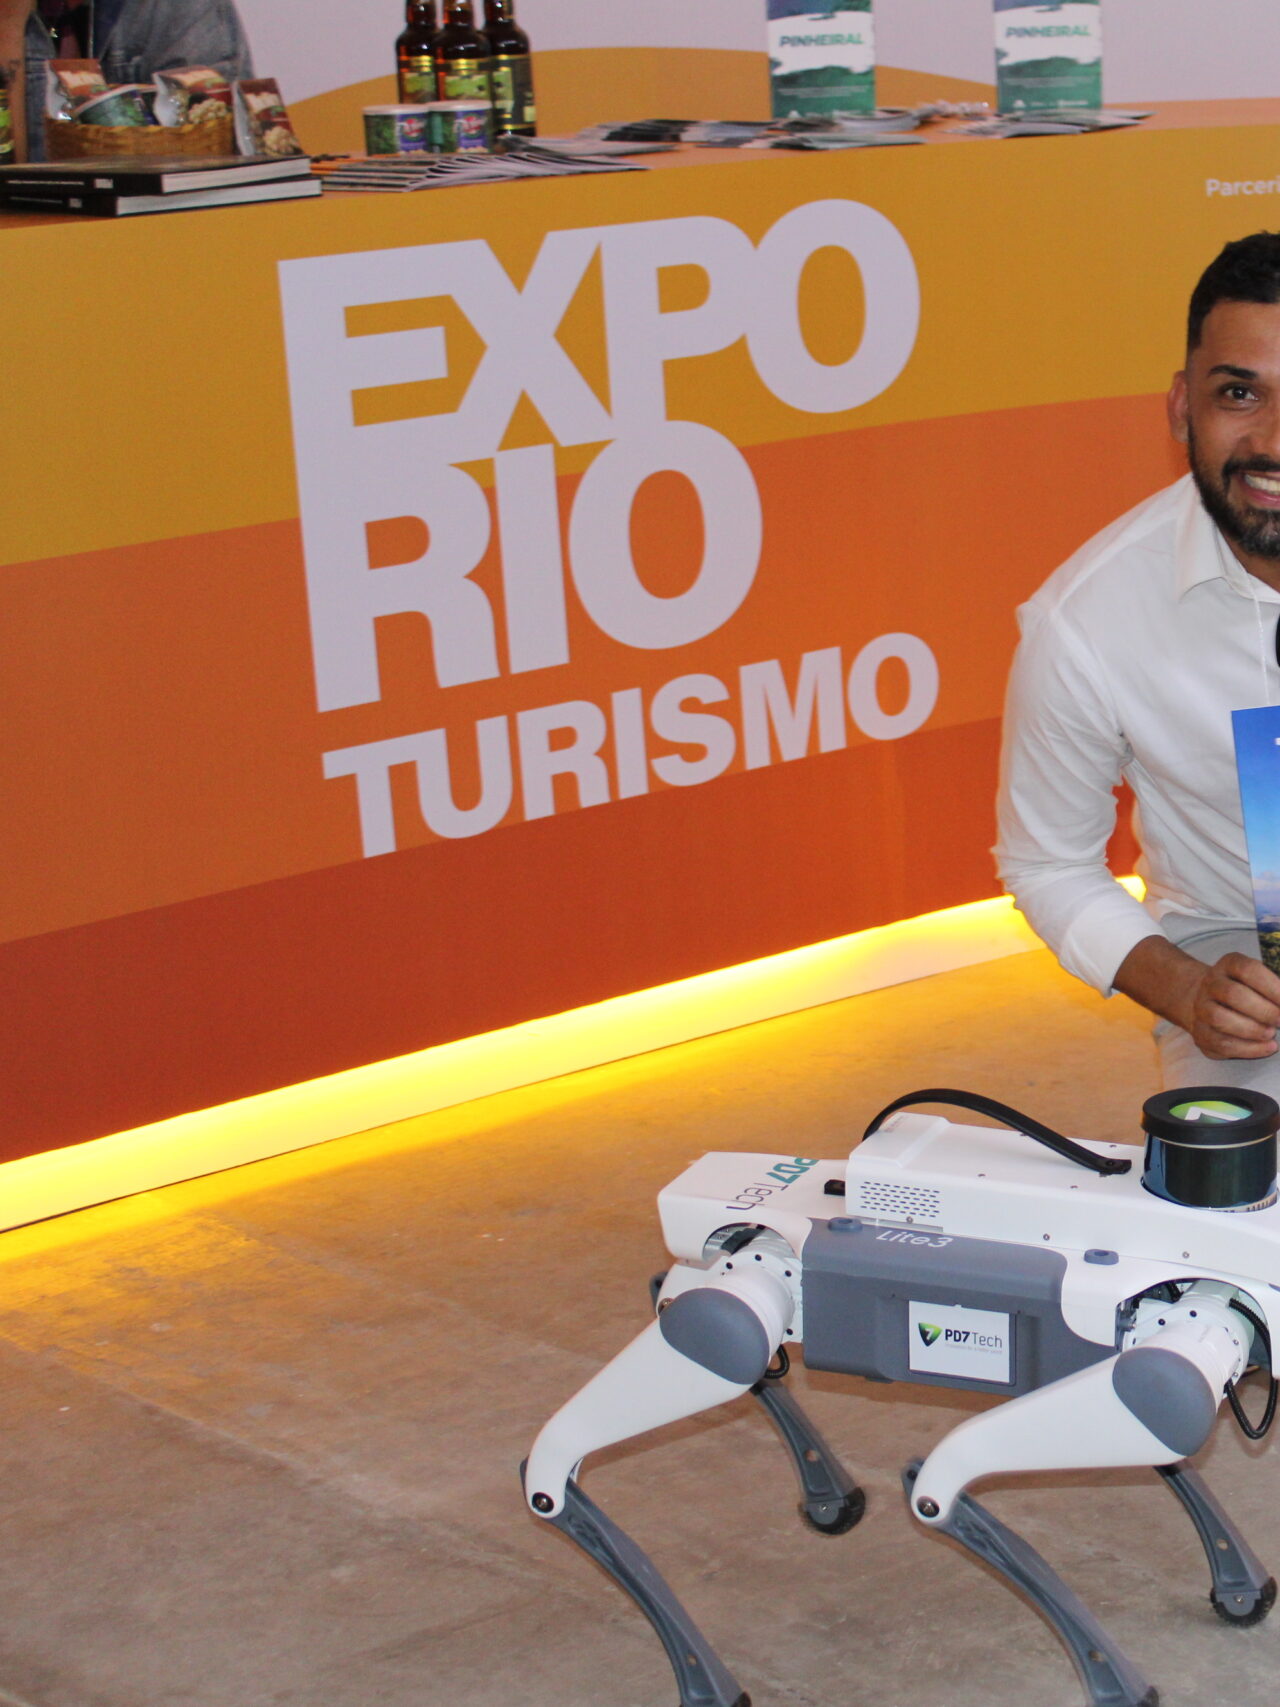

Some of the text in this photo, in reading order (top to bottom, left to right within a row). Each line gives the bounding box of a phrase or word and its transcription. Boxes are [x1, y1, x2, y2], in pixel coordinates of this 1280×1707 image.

[779, 33, 864, 48] PINHEIRAL
[277, 198, 921, 472] EXPO
[296, 420, 763, 714] RIO
[322, 632, 940, 859] TURISMO
[876, 1230, 954, 1248] Lite3
